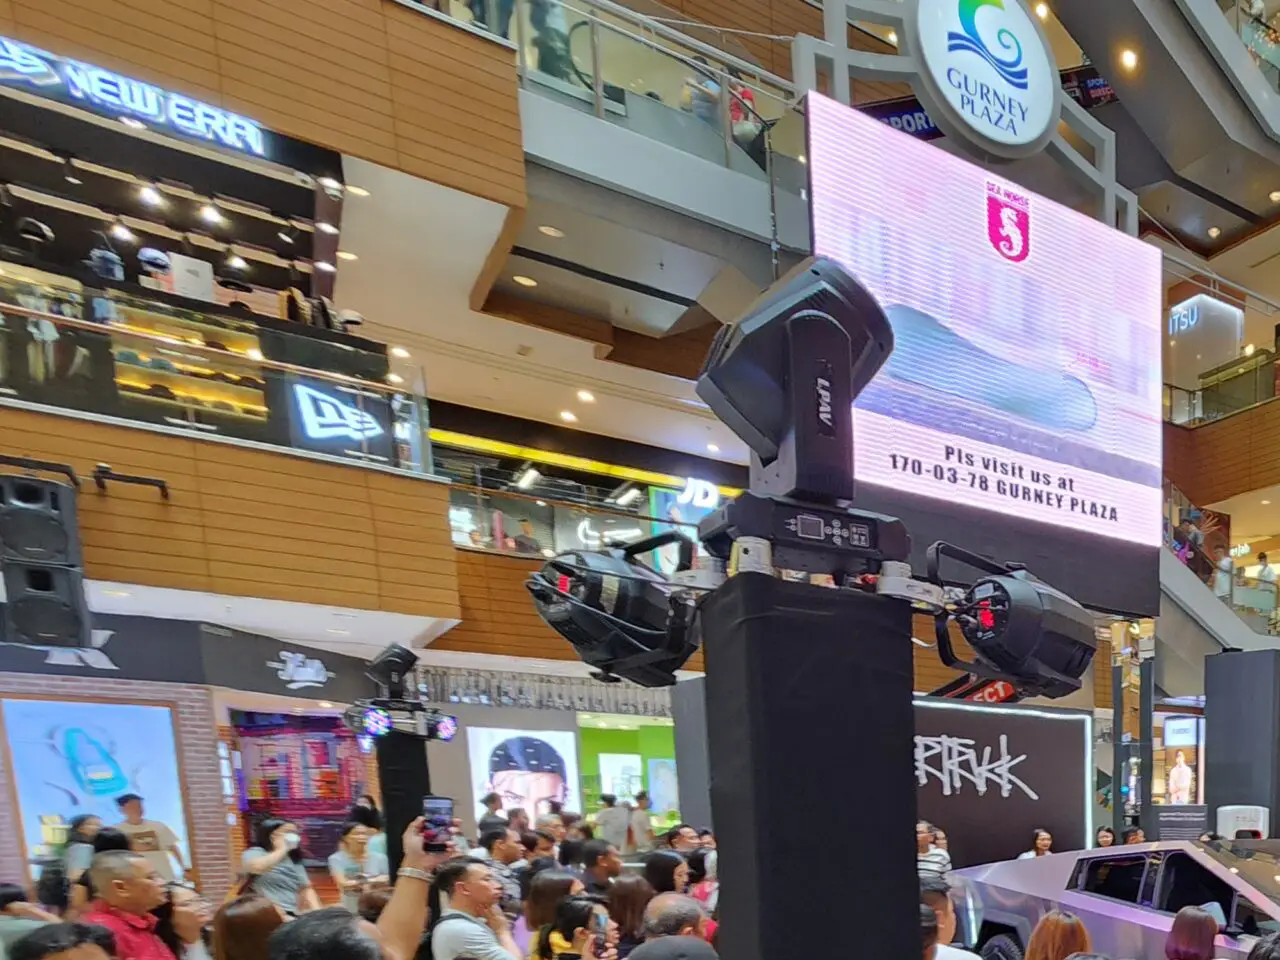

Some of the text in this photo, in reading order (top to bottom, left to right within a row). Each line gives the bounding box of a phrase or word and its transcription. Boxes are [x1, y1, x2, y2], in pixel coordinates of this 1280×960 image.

[66, 58, 264, 156] NEW ERA
[947, 67, 1029, 122] GURNEY
[960, 94, 1017, 136] PLAZA
[1168, 304, 1198, 336] ITSU
[889, 454, 1119, 522] 170-03-78 GURNEY PLAZA
[944, 445, 1075, 492] Pls visit us at
[676, 477, 720, 508] JD
